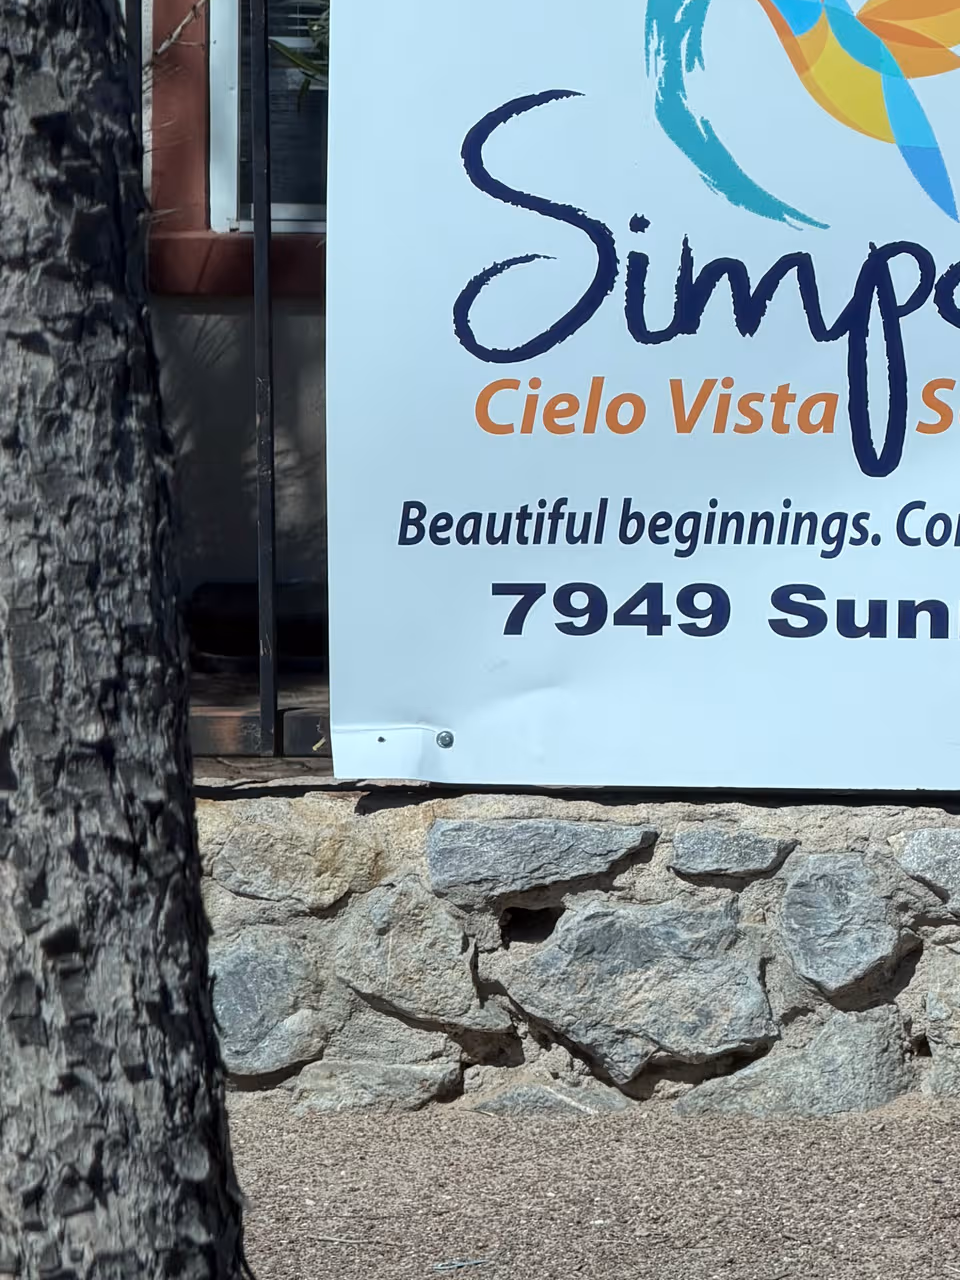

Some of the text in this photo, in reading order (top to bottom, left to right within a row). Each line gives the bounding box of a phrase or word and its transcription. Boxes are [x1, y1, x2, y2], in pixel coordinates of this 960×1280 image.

[475, 376, 646, 435] Cielo
[669, 376, 839, 435] Vista
[397, 496, 609, 546] Beautiful
[618, 497, 882, 560] beginnings.
[491, 581, 731, 638] 7949
